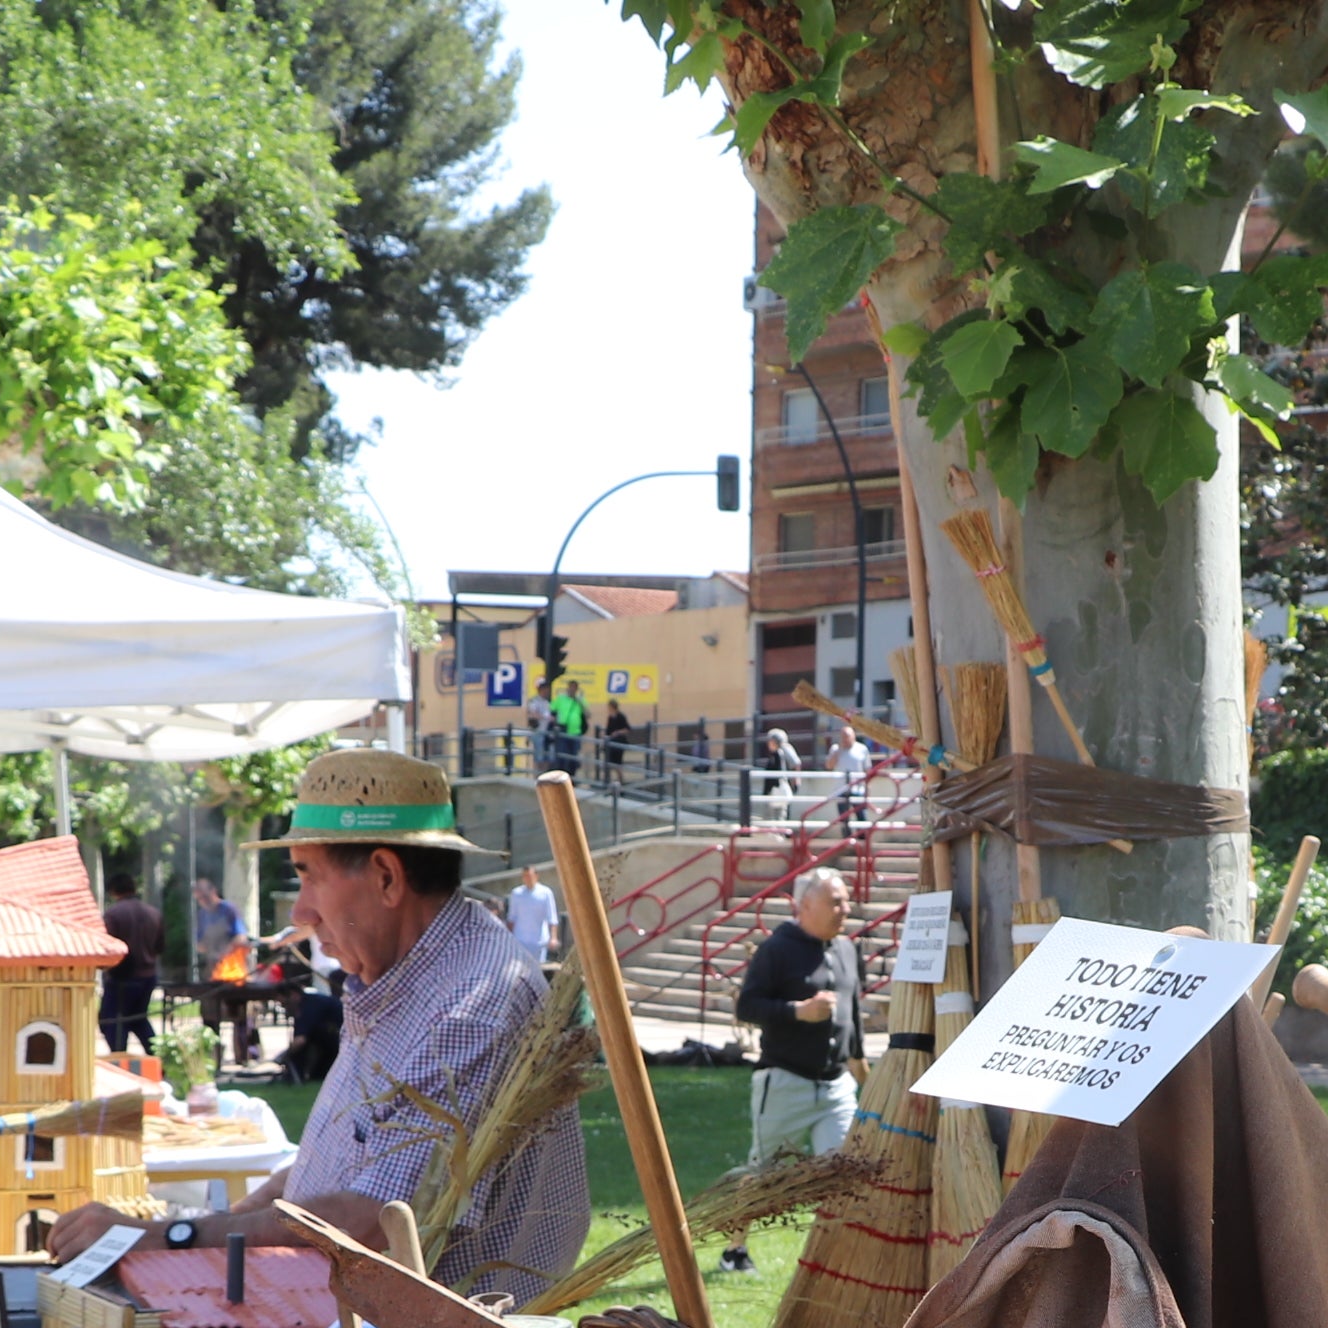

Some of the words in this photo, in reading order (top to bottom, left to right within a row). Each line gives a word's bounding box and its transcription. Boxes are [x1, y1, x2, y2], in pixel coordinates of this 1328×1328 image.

[1065, 957, 1138, 989] TODO
[1129, 967, 1208, 1001] TIENE
[1045, 995, 1160, 1032] HISTORIA
[981, 1052, 1121, 1090] EXPLICAREMOS
